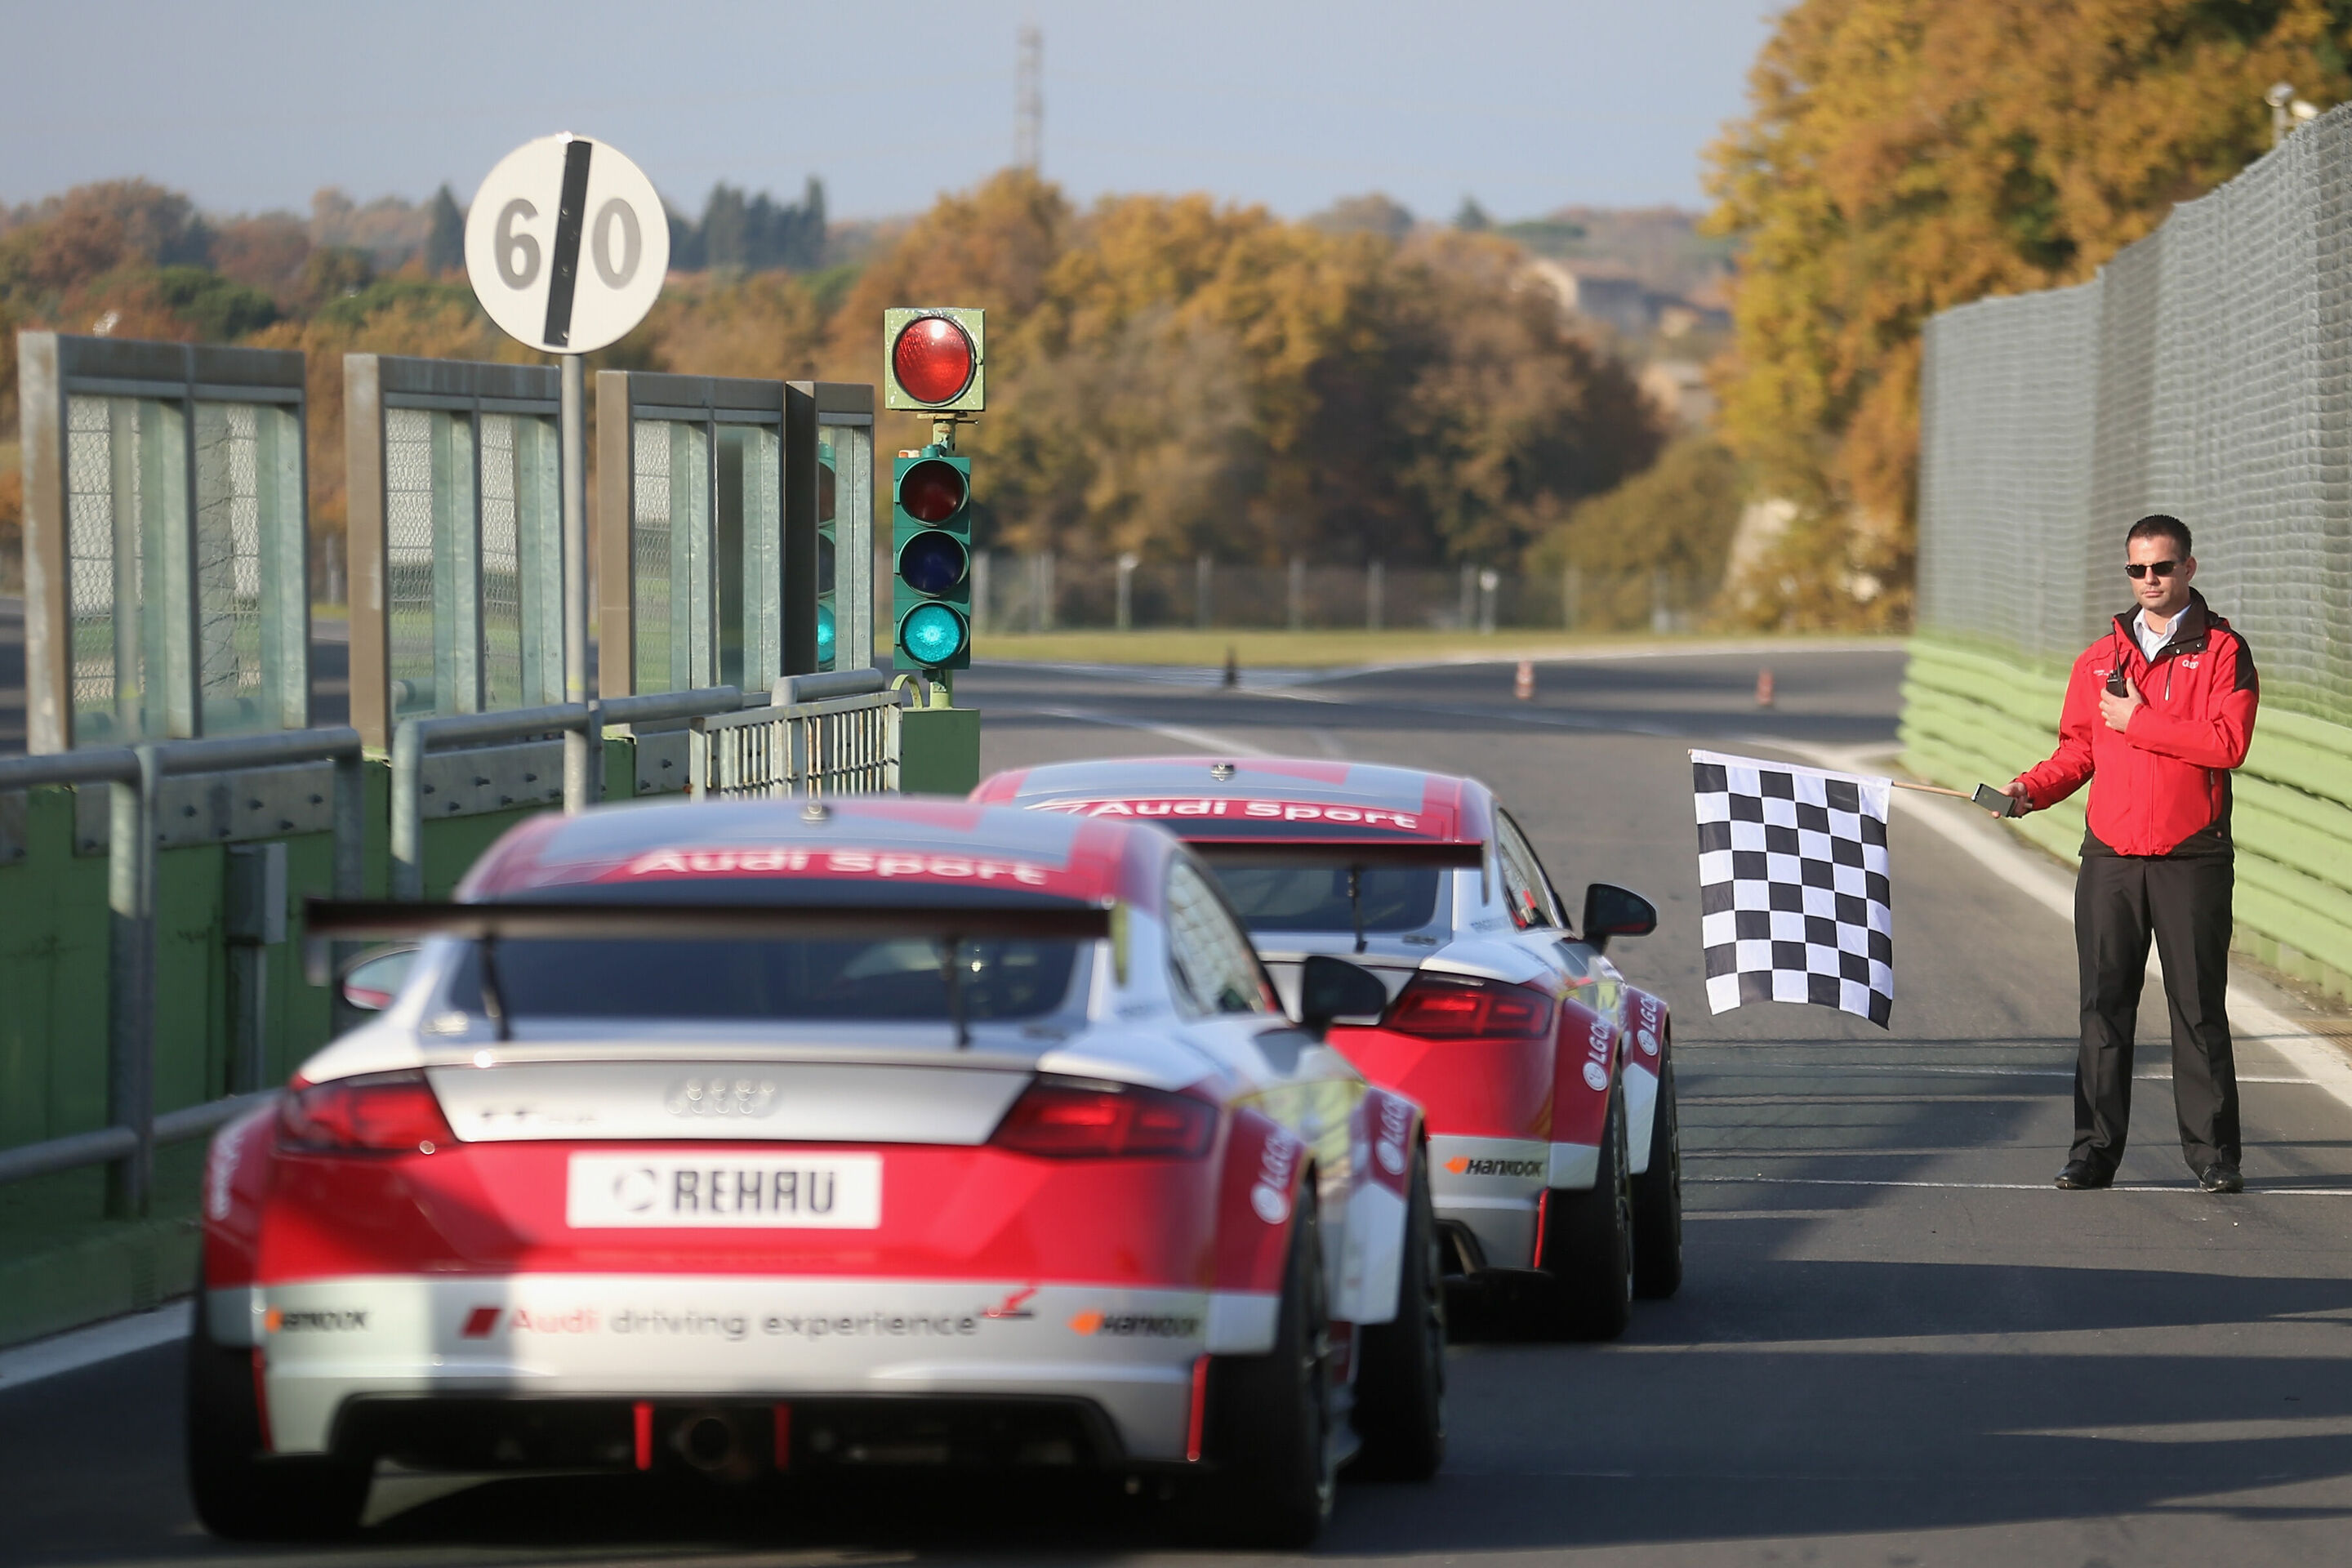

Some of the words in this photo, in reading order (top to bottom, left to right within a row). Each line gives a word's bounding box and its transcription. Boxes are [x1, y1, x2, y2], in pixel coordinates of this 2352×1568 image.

[494, 198, 643, 290] 60
[1087, 800, 1227, 818] Audi
[1244, 801, 1418, 830] Sport
[629, 848, 811, 876] Audi
[826, 849, 1048, 887] Sport
[673, 1169, 836, 1215] REHAU
[508, 1308, 600, 1334] Audi
[609, 1308, 751, 1343] driving
[763, 1310, 978, 1341] experience
